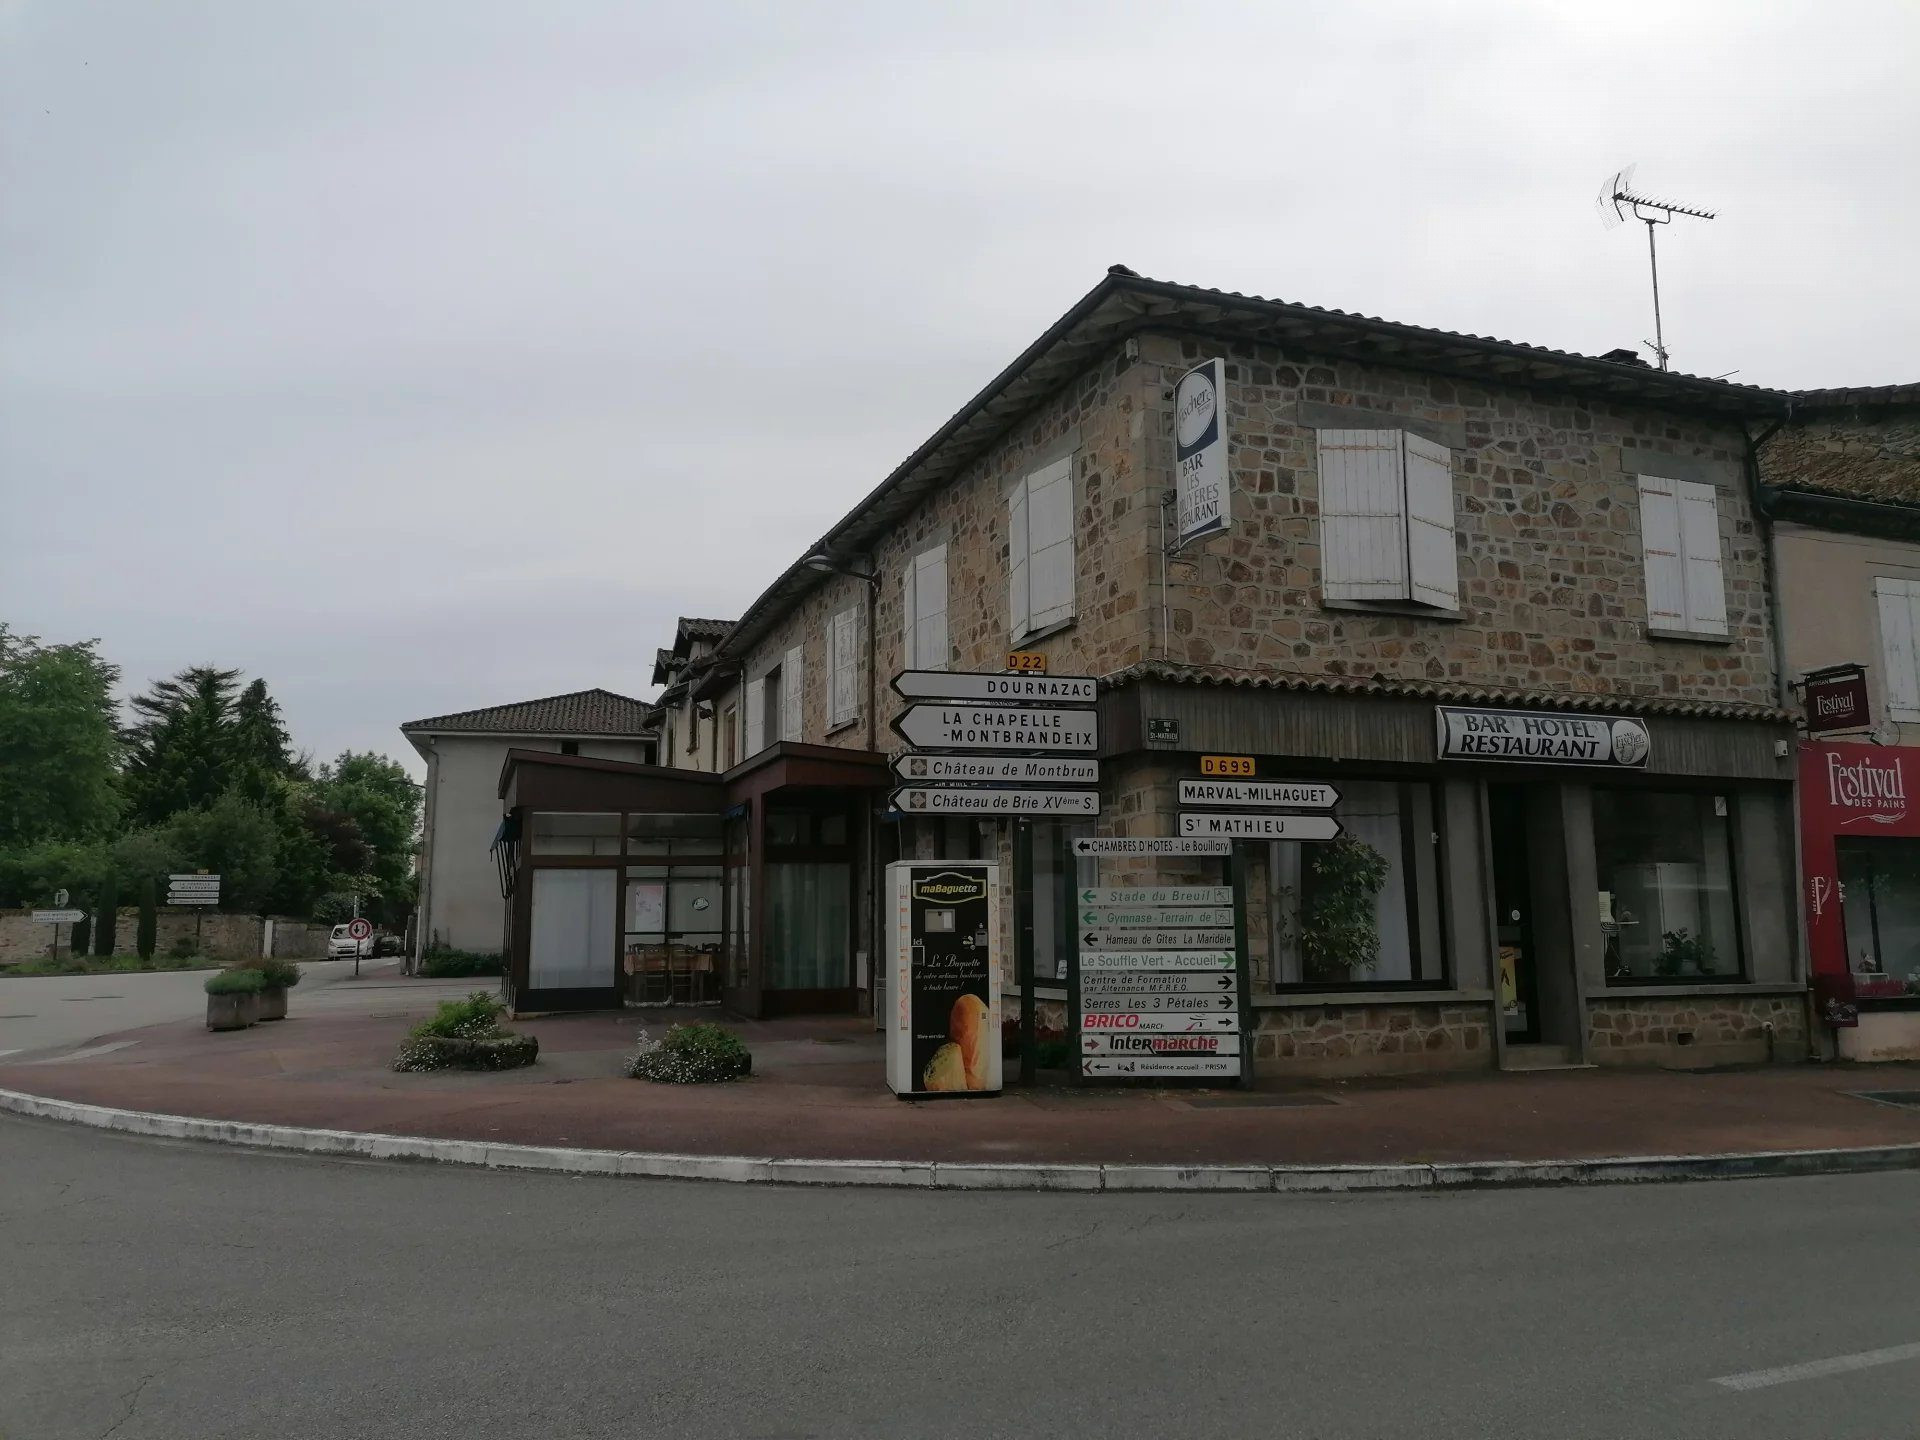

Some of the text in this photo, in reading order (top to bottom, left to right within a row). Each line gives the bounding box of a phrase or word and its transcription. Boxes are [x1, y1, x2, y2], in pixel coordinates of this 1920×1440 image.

[1183, 453, 1203, 476] BAR
[1187, 472, 1200, 491] LES
[1009, 656, 1042, 669] D 22
[987, 680, 1092, 697] DOURNAZAC
[1816, 691, 1854, 716] Festival
[943, 712, 1061, 728] LA CHAPELLE
[1464, 714, 1595, 738] BAR HOTEL
[943, 729, 1092, 745] -MONTBRANDEIX
[1460, 734, 1600, 759] RESTAURANT
[933, 761, 1094, 777] Château de Montbrun
[1205, 760, 1250, 773] D 699
[1826, 752, 1906, 806] Festival
[1184, 785, 1326, 802] MARVAL-MILHAGUET
[932, 793, 990, 808] Château
[993, 795, 1008, 808] de
[1012, 795, 1038, 809] Brie
[1855, 799, 1905, 808] DES PAINS
[1210, 820, 1284, 833] MATHIEU
[1091, 840, 1137, 852] CHAMBRES
[1139, 840, 1173, 851] D'HOTES
[1181, 841, 1190, 851] Le
[921, 884, 978, 894] maBaguette
[1110, 890, 1210, 902] Stade du Breuil
[1107, 912, 1152, 924] Gymnase
[1160, 912, 1193, 922] Terrain
[1200, 911, 1211, 922] de
[1106, 934, 1138, 945] Hameau
[1142, 934, 1151, 944] de
[1184, 934, 1193, 944] La
[945, 953, 980, 971] Baguette
[1081, 956, 1094, 966] Le
[1100, 955, 1138, 966] Souffle
[1142, 955, 1164, 966] Vert
[1175, 955, 1216, 966] Accueil
[1083, 975, 1187, 984] Centre de Formation
[1083, 985, 1098, 993] par
[1101, 984, 1145, 992] Alternance
[1084, 998, 1209, 1009] Serres Les 3 Pétales
[1083, 1014, 1139, 1028] BRICO
[1109, 1035, 1219, 1051] Intermarché
[1140, 1063, 1174, 1071] Résidence
